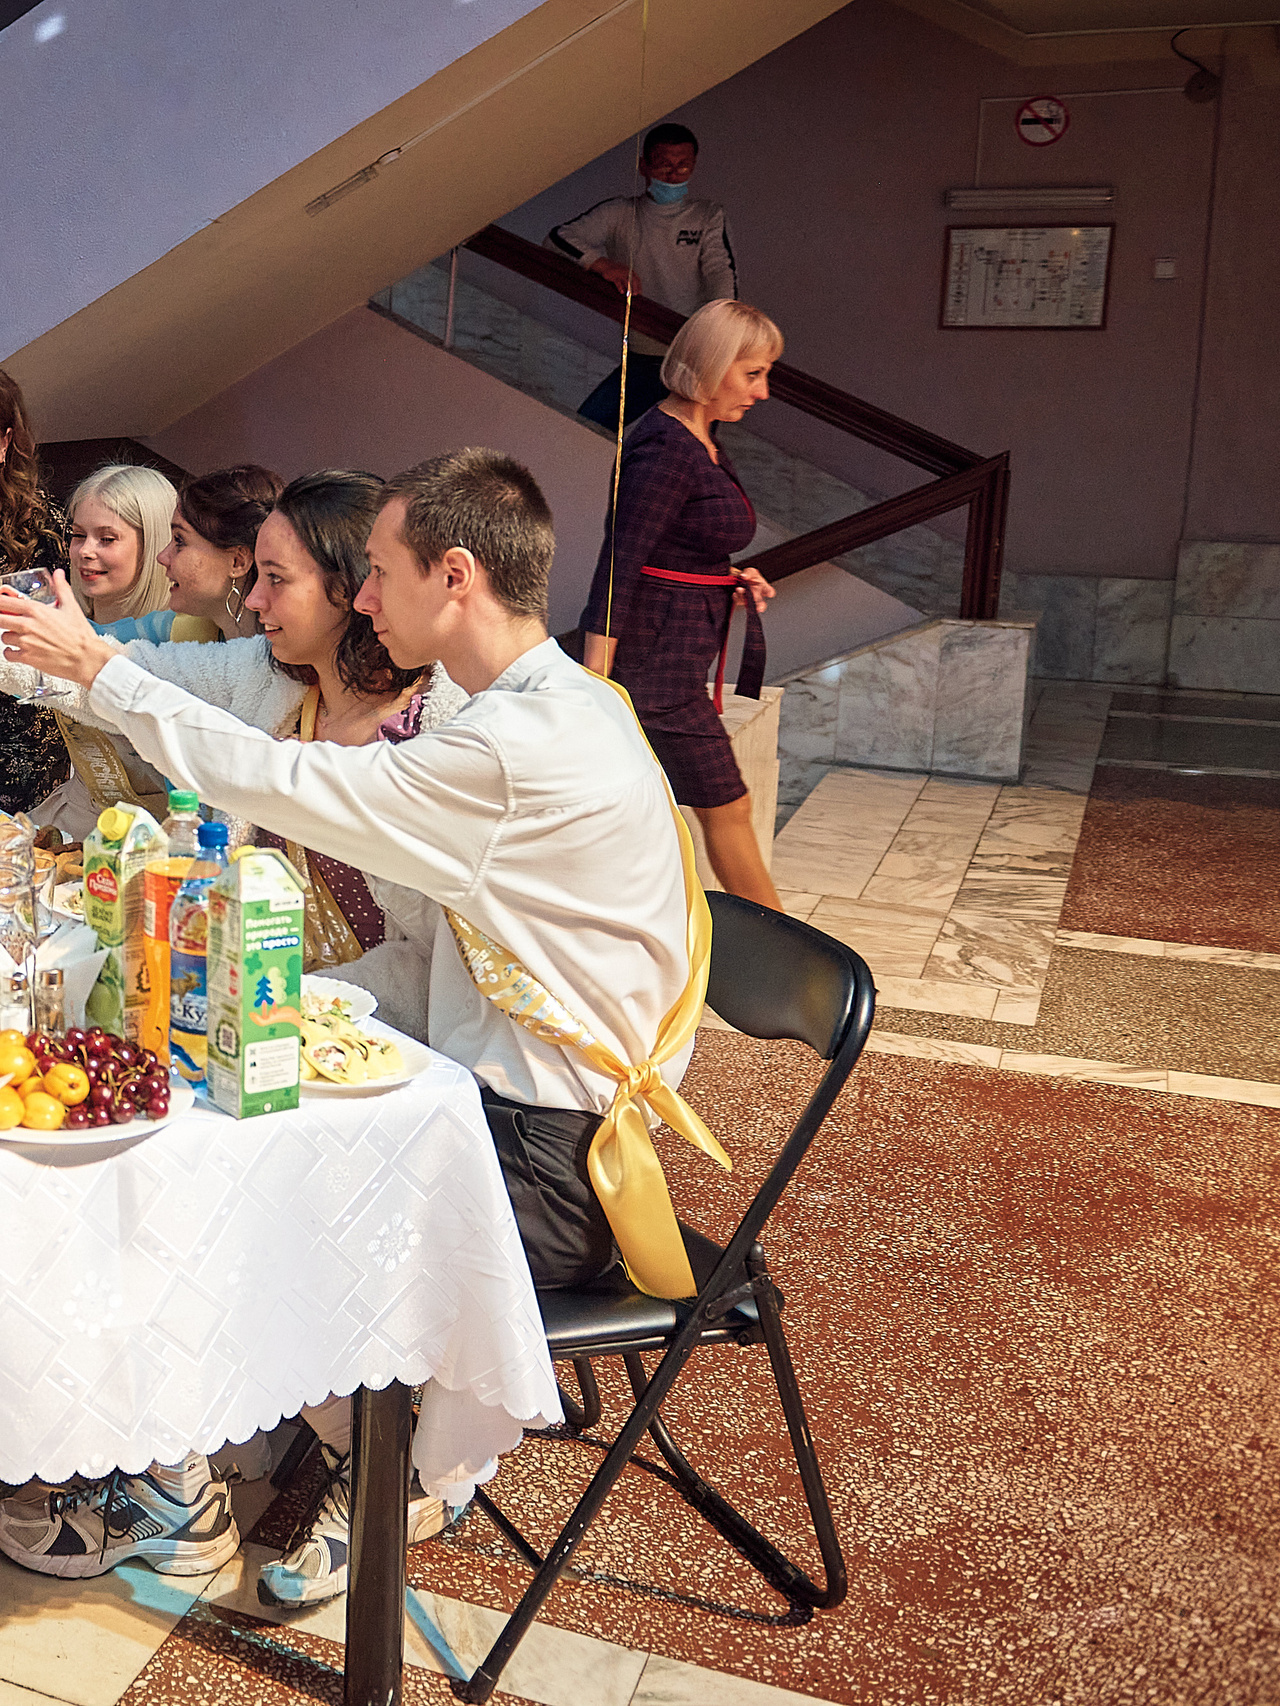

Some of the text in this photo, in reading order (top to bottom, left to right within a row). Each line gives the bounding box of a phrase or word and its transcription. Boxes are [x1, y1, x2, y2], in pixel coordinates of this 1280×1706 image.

[245, 916, 293, 929] Помогать
[245, 927, 289, 941] природе
[262, 937, 299, 950] просто
